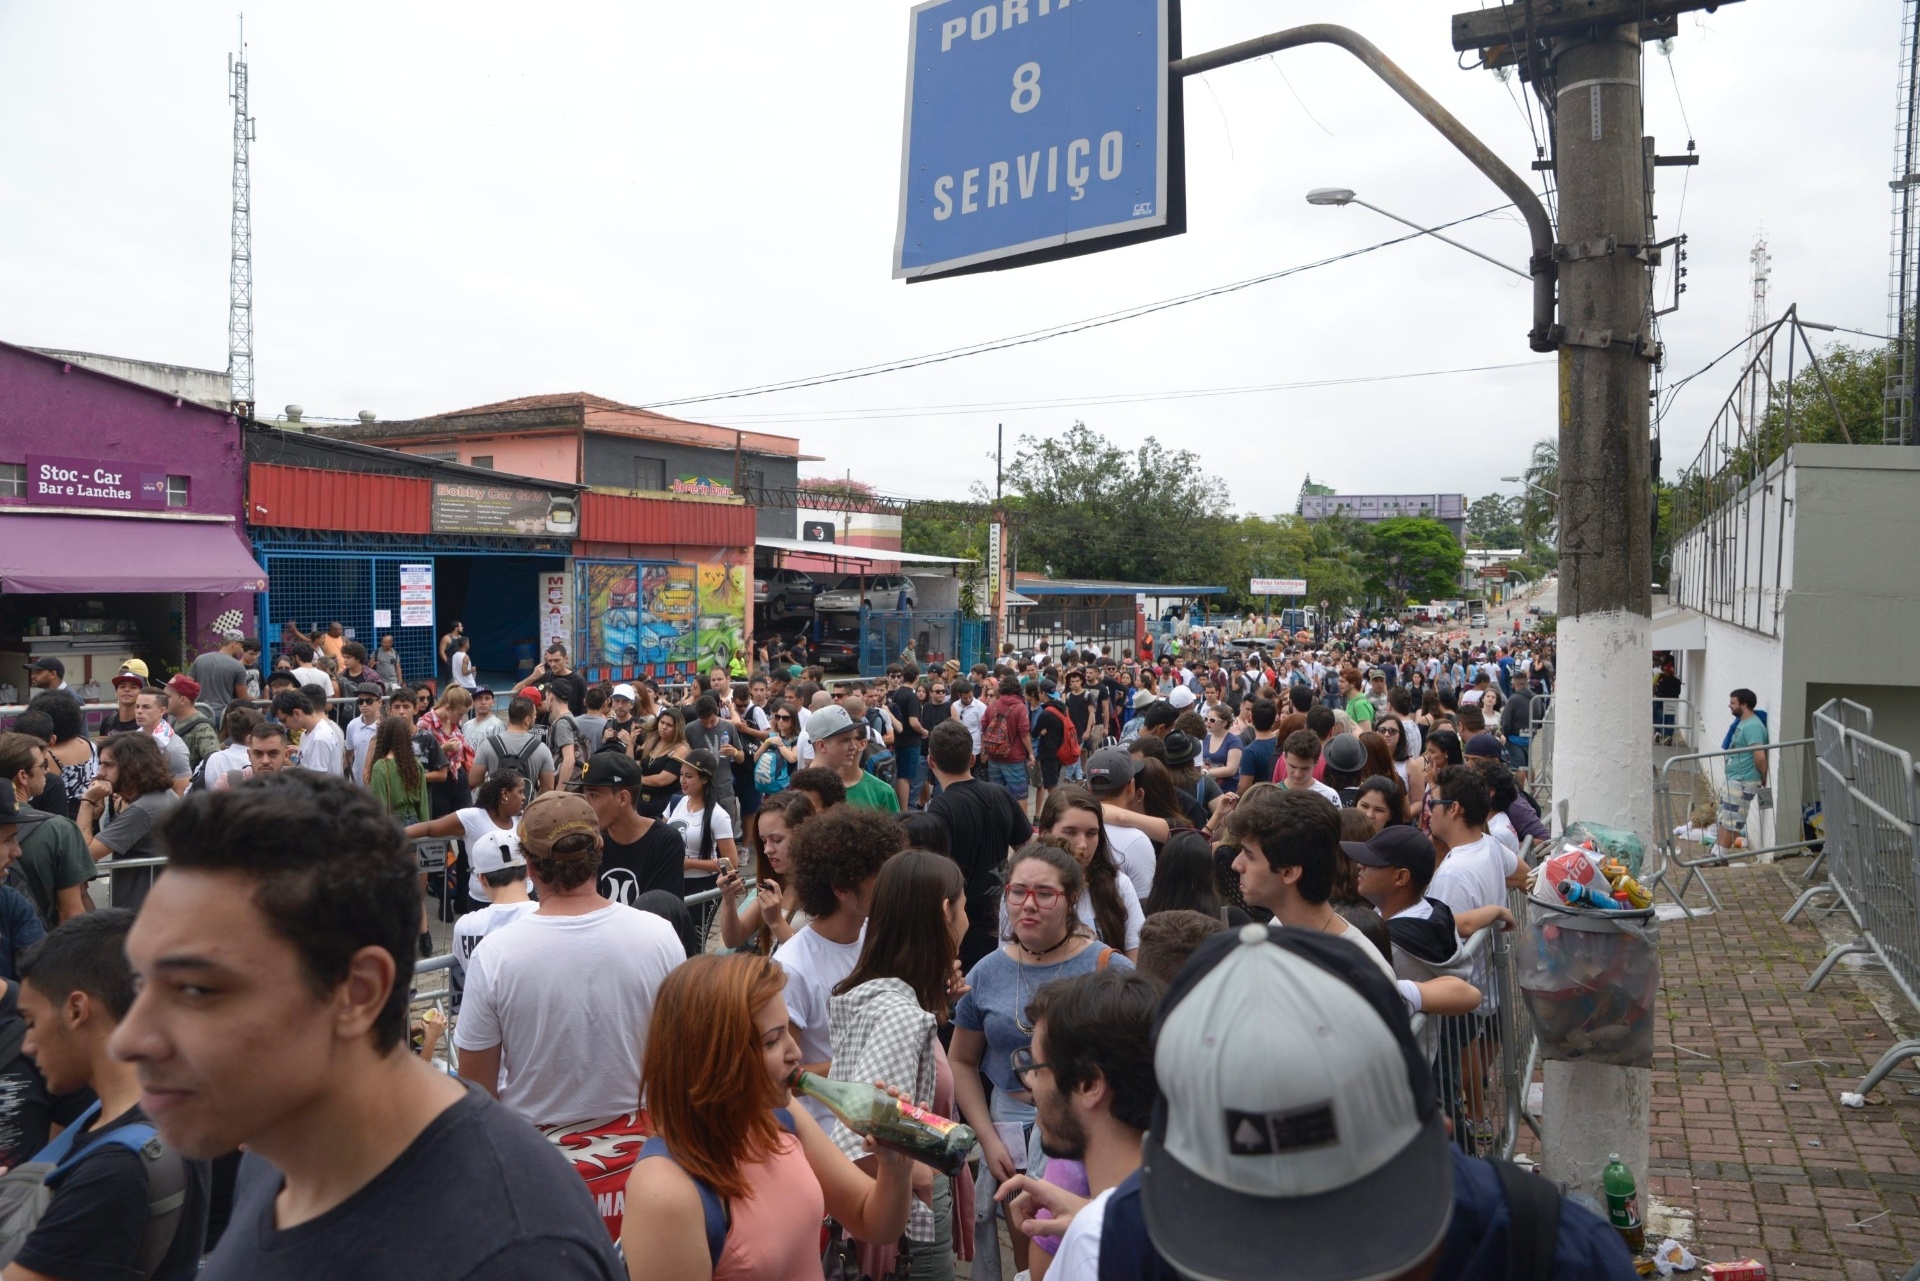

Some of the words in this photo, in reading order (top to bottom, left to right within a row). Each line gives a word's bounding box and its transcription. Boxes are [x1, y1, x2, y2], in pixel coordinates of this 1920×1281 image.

[1010, 61, 1041, 114] 8
[933, 130, 1123, 222] SERVIÇO
[40, 464, 78, 482] Stoc
[93, 469, 122, 486] Car
[38, 482, 64, 496] Bar
[66, 485, 74, 495] e
[77, 484, 132, 500] Lanches
[437, 485, 484, 500] Bobby
[487, 487, 513, 500] Car
[516, 491, 543, 502] GNV
[1274, 580, 1305, 588] Interlagos
[755, 753, 773, 785] NIKE
